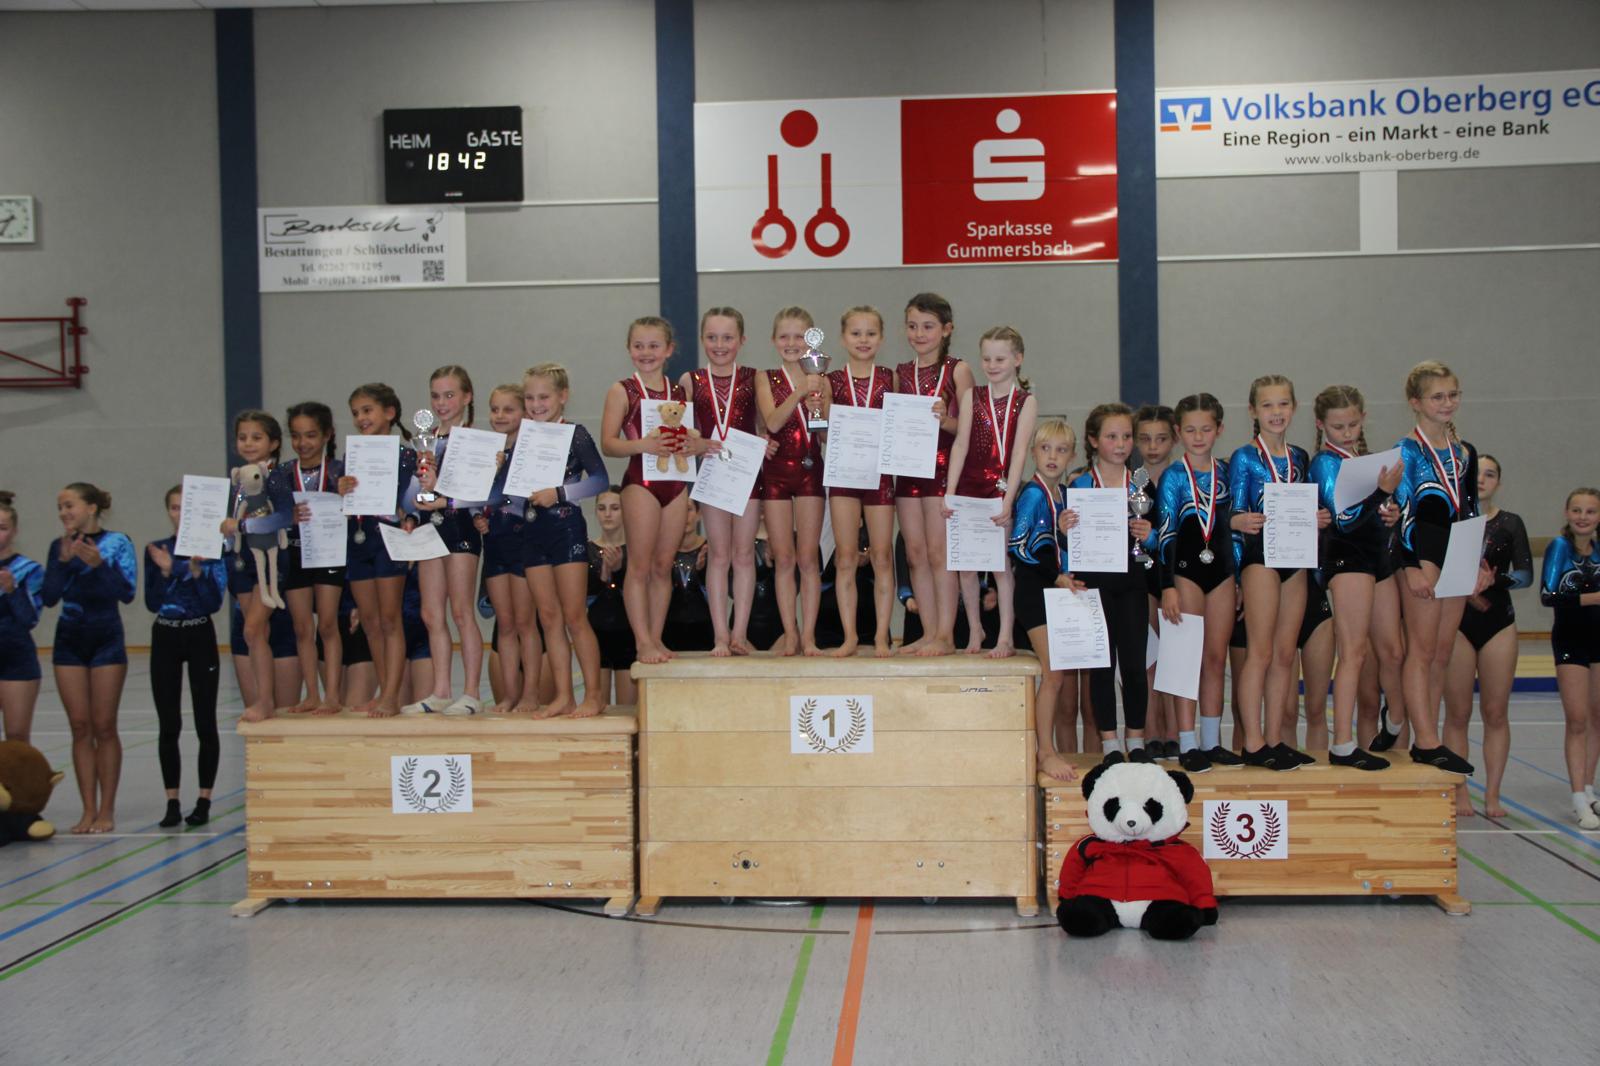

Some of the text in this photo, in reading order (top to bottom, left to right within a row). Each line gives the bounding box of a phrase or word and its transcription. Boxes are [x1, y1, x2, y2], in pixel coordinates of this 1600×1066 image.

[1222, 80, 1600, 121] Volksbank Oberberg eG
[389, 129, 522, 149] HEIM GÄSTE
[1223, 131, 1261, 147] Eine
[1267, 129, 1330, 148] Region
[1348, 127, 1376, 143] ein
[1383, 125, 1438, 142] Markt
[1455, 122, 1496, 139] eine
[1503, 119, 1550, 136] Bank
[427, 151, 487, 171] 18 42
[1285, 147, 1480, 166] www.volksbank-oberberg.de
[966, 221, 1052, 240] Sparkasse
[264, 246, 343, 258] Bestattungen
[353, 244, 445, 257] Schlüsseldienst
[947, 240, 1074, 258] Gummersbach
[282, 276, 309, 286] Mobil
[826, 420, 842, 480] URKUNDE
[880, 408, 896, 468] URKUNDE
[1266, 500, 1276, 562] URKUNDE
[157, 616, 208, 627] NIKE PRO
[1087, 594, 1105, 653] URKUNDE
[821, 709, 838, 739] 1
[422, 769, 442, 799] 2
[1236, 813, 1256, 843] 3
